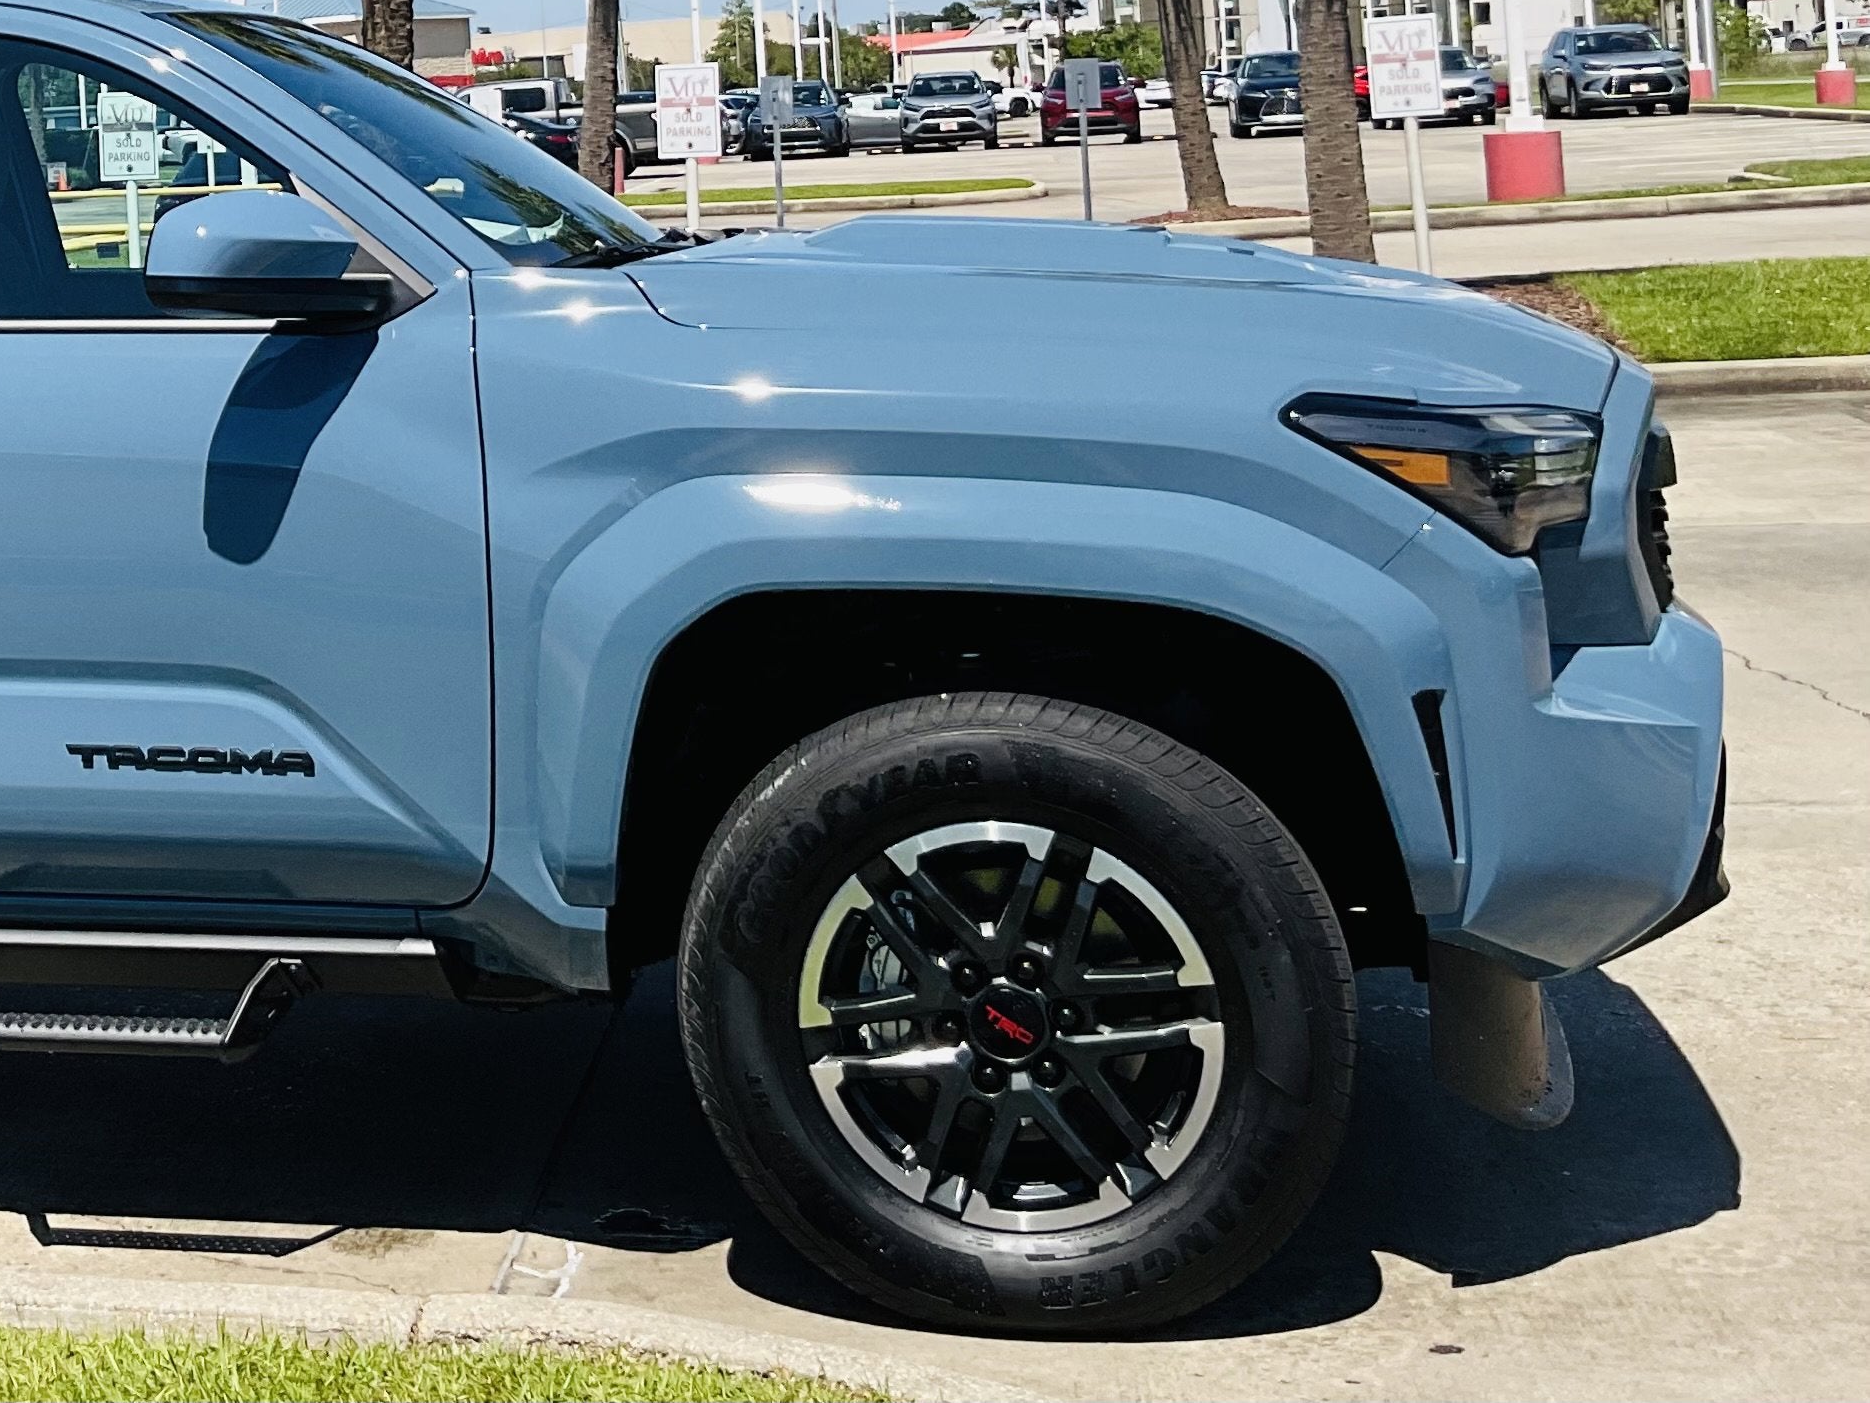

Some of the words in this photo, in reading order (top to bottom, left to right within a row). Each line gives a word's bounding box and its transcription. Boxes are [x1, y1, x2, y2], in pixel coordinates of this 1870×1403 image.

[1388, 68, 1420, 79] SOLD
[1379, 83, 1432, 96] PARKING
[674, 111, 702, 123] SOLD
[665, 126, 712, 137] PARKING
[115, 138, 142, 148] SOLD
[108, 151, 151, 163] PARKING
[65, 743, 317, 778] TACOMA
[984, 1004, 1034, 1046] TRD
